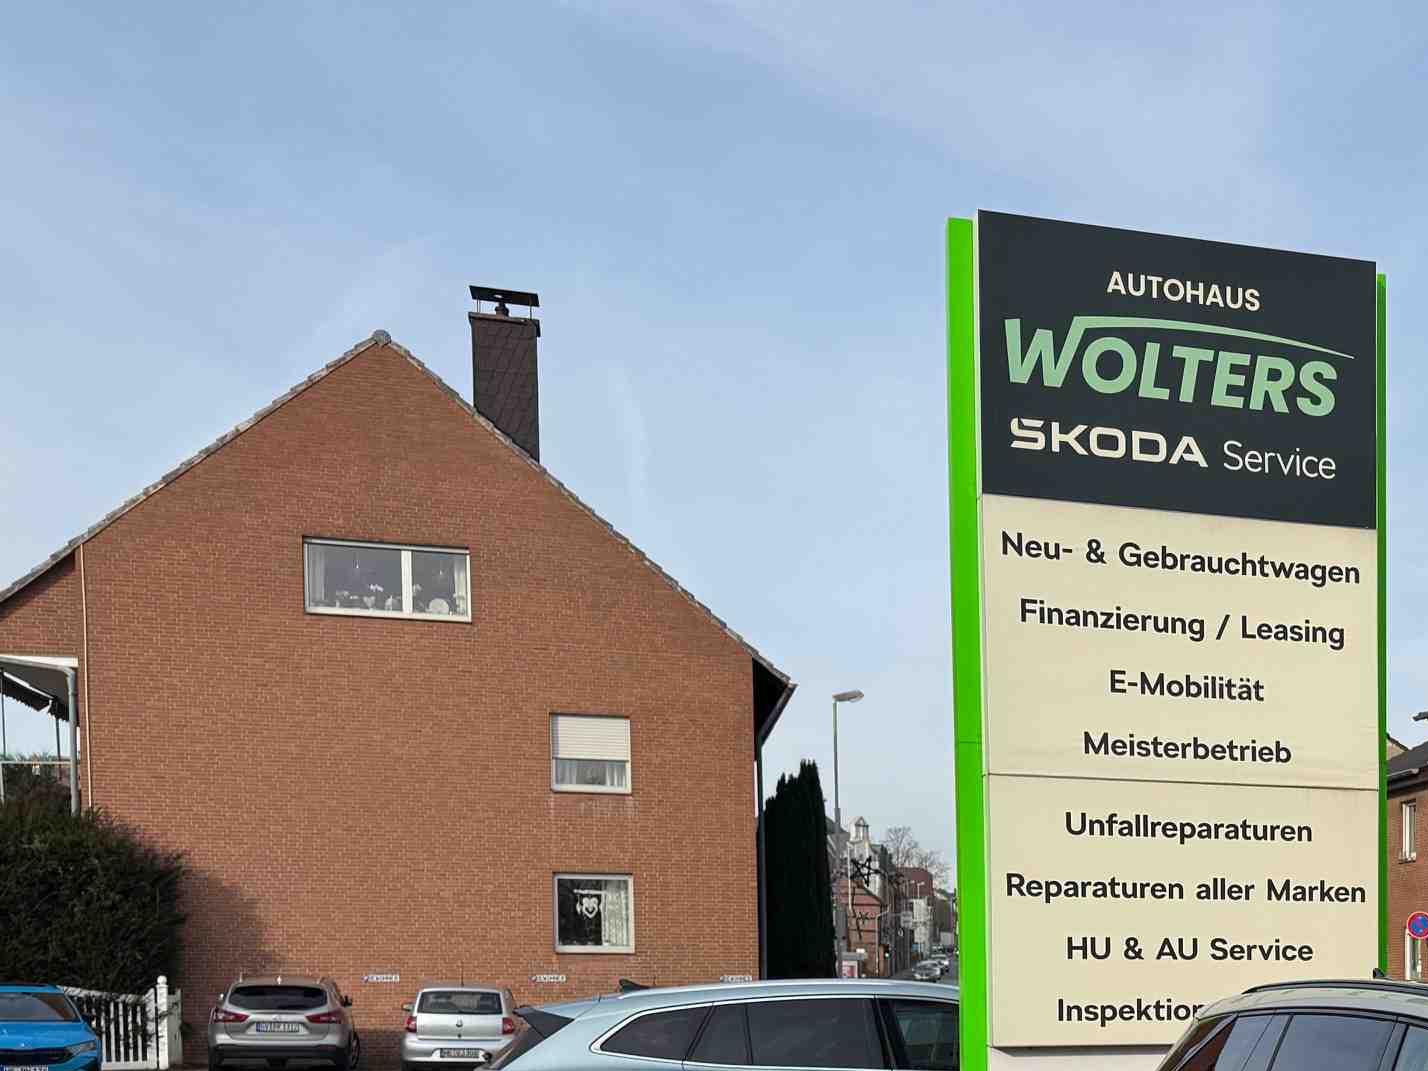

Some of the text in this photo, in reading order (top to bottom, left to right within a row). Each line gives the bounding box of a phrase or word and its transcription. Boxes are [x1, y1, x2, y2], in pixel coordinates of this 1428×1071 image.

[1107, 271, 1261, 312] AUTOHAUS
[1004, 316, 1340, 417] WOLTERS
[1223, 441, 1337, 480] Service
[1001, 531, 1360, 587] Neu- & Gebrauchtwagen
[1020, 598, 1345, 650] Finanzierung / Leasing
[1110, 669, 1265, 702] E-Mobilität
[1083, 731, 1292, 763] Meisterbetrieb
[1065, 812, 1313, 845] Unfallreparaturen
[1006, 873, 1367, 904] Reparaturen aller Marken
[1066, 937, 1314, 962] HU & AU Service
